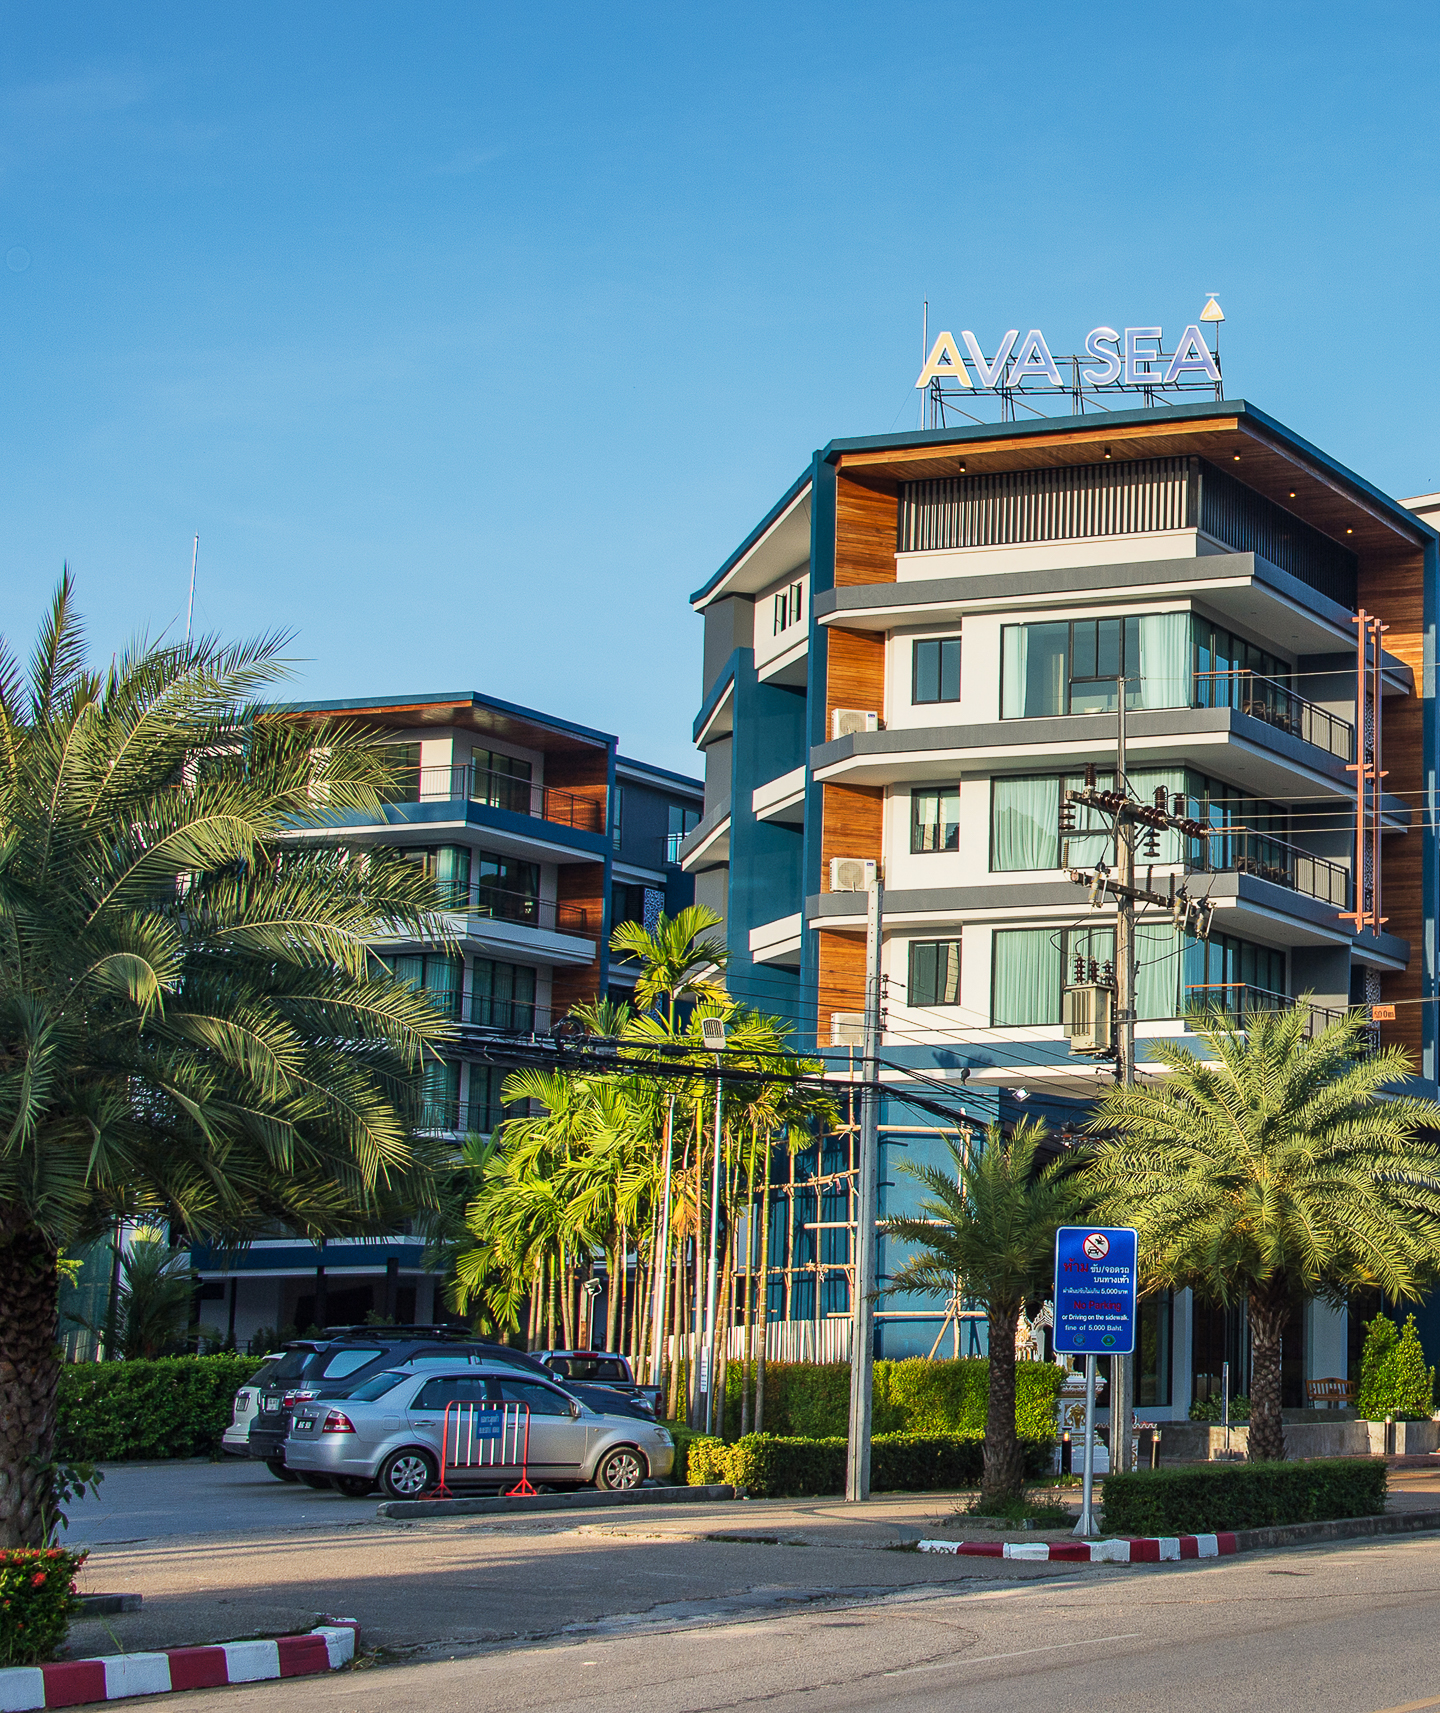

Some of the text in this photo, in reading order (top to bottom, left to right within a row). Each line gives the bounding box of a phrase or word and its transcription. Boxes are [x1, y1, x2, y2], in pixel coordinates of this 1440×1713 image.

[915, 325, 1223, 389] AVA SEA
[1063, 1258, 1129, 1273] ห้าม ขับ/จอดรถ
[1094, 1275, 1129, 1283] บนทางเท้า
[1074, 1301, 1121, 1312] No Parking
[1068, 1313, 1087, 1322] Driving
